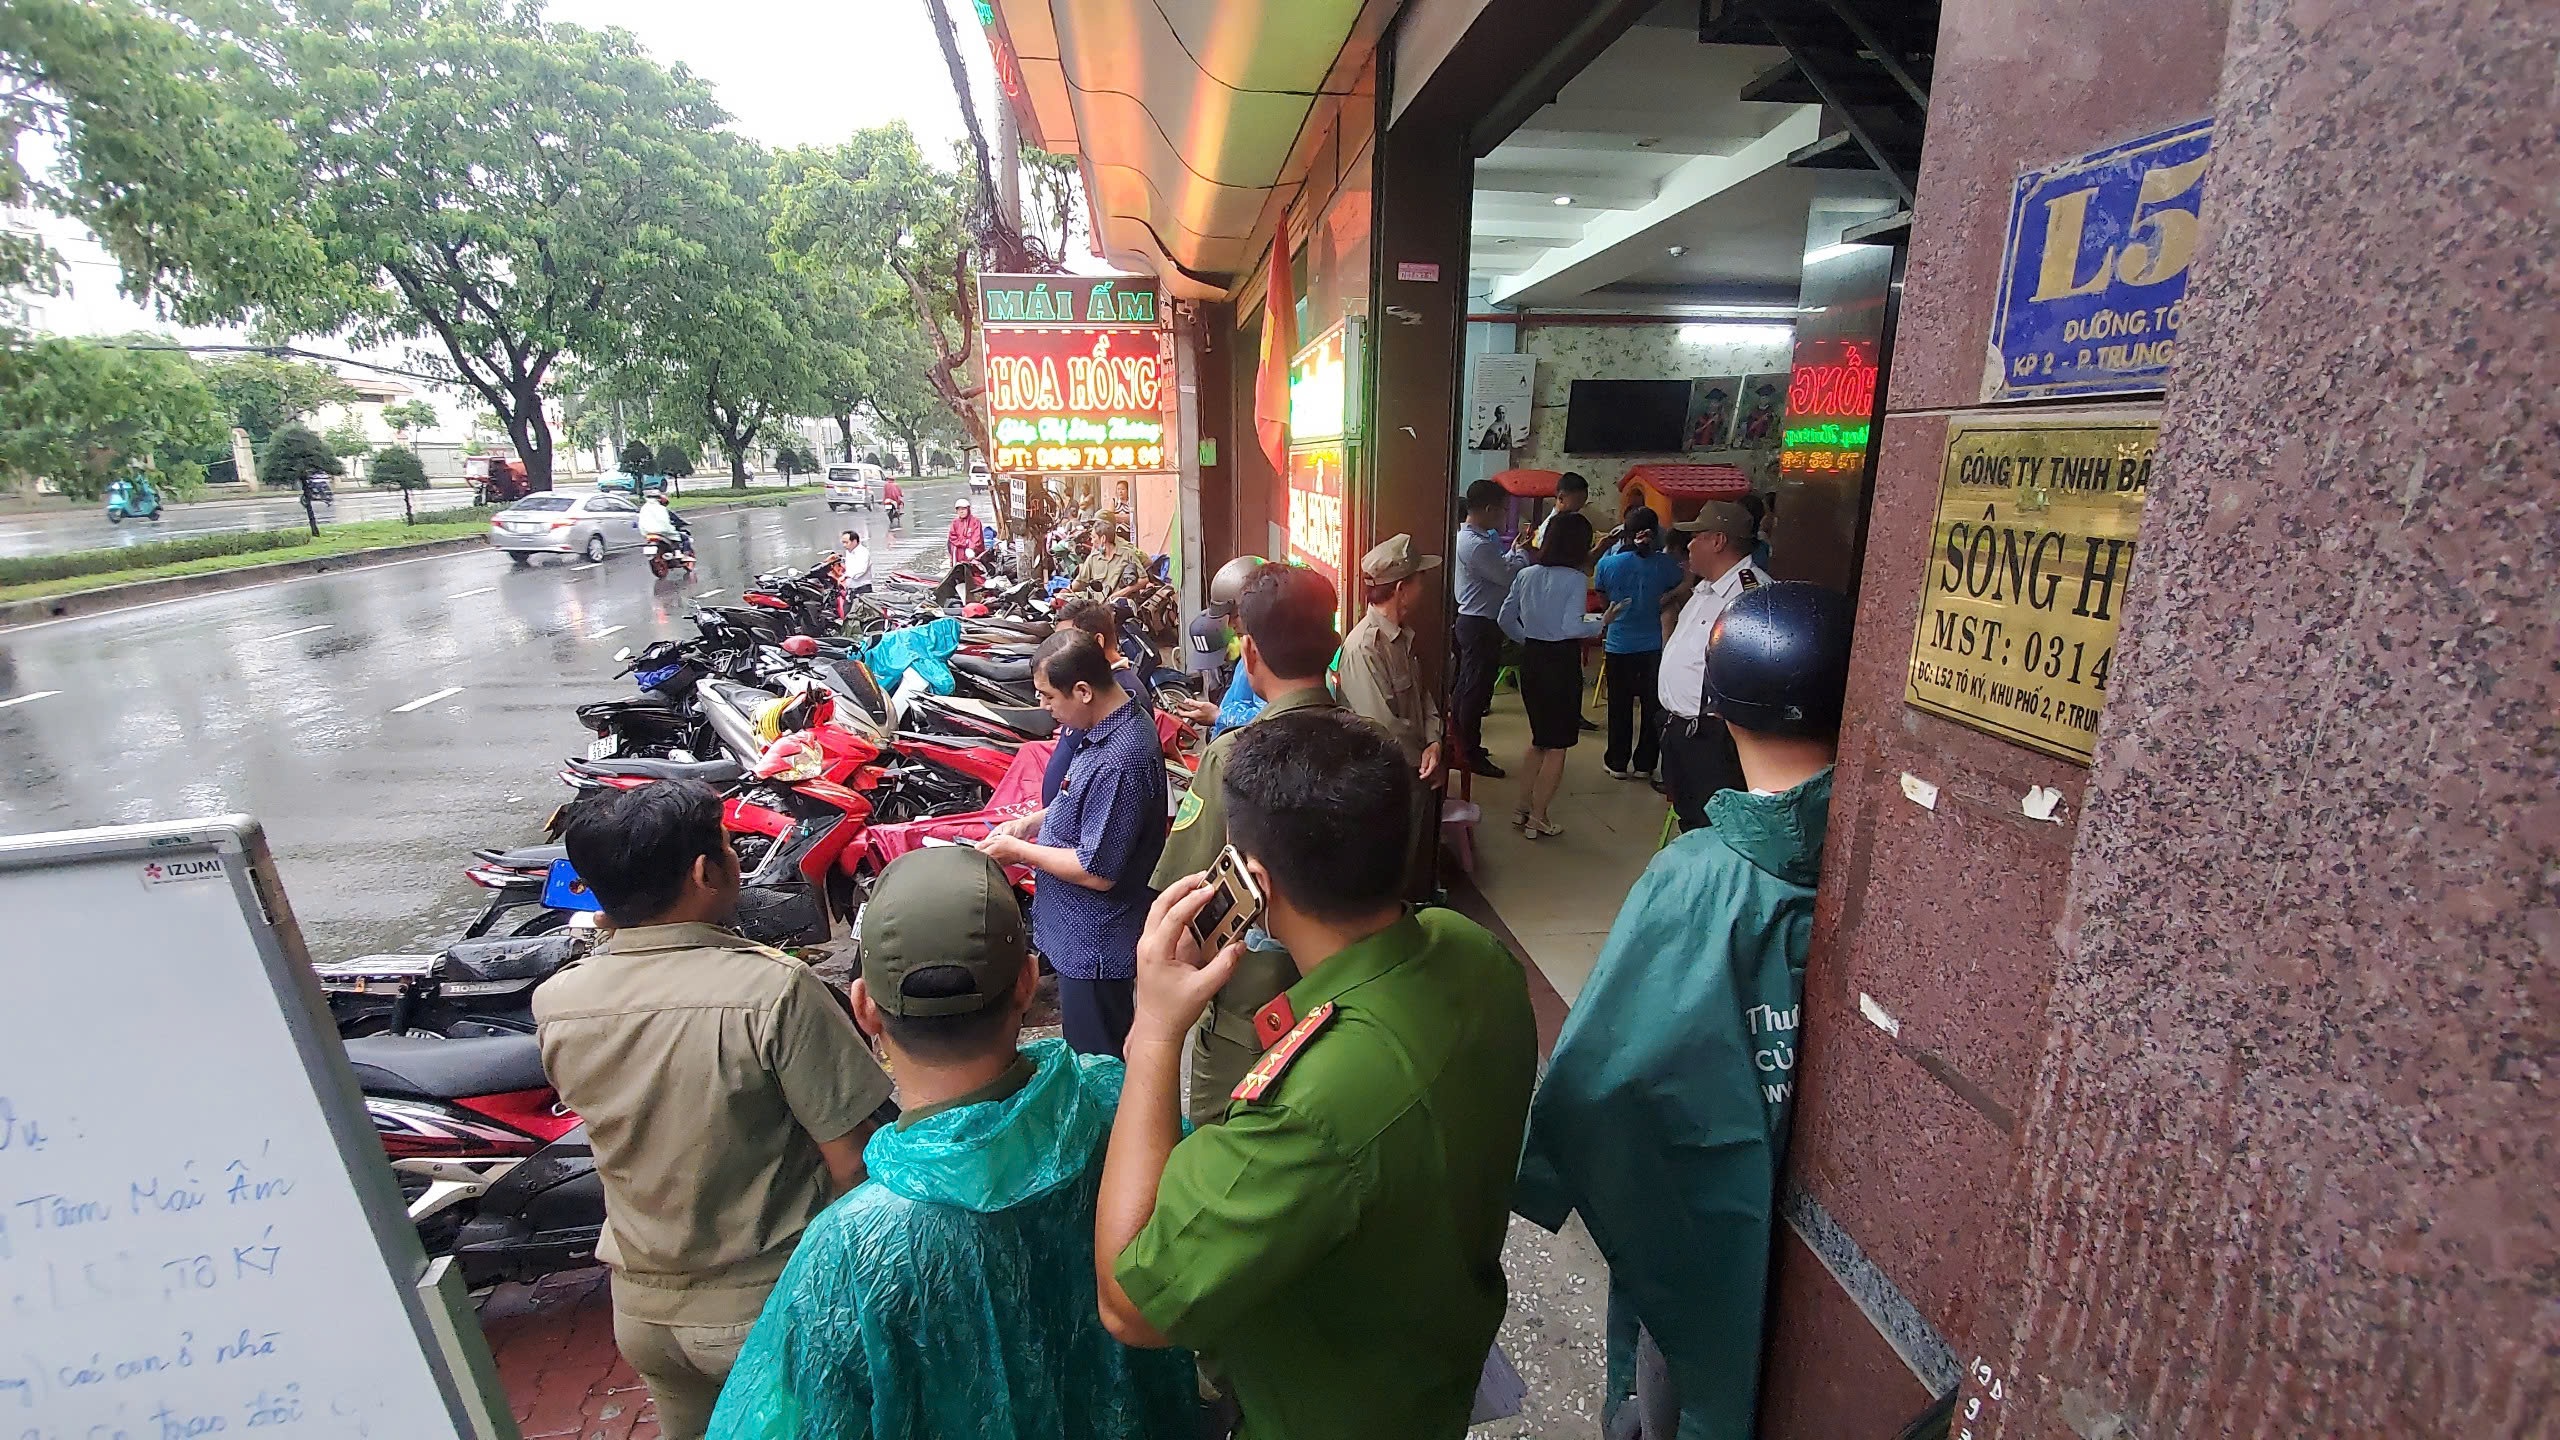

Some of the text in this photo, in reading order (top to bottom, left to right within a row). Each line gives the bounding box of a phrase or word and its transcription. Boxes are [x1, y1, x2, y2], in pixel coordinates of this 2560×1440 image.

[987, 281, 1154, 321] MÁI ẤM
[990, 356, 1064, 411] HOA
[2013, 353, 2037, 377] KP
[2043, 353, 2055, 375] 2
[1960, 450, 2011, 489] CÔNG
[2015, 455, 2045, 488] TY
[2050, 458, 2112, 491] TNHH
[1940, 504, 2067, 611] SÔNG
[1930, 609, 2113, 691] MST: 0314
[1917, 661, 1934, 683] ĐC:
[1935, 665, 1952, 690] L52
[1954, 668, 1969, 695] TÔ
[1970, 673, 1987, 705] KÝ,
[1989, 679, 2013, 709] KHU
[2015, 686, 2043, 716] PHỐ
[2040, 698, 2053, 724] 2,
[167, 860, 221, 876] IZUMI
